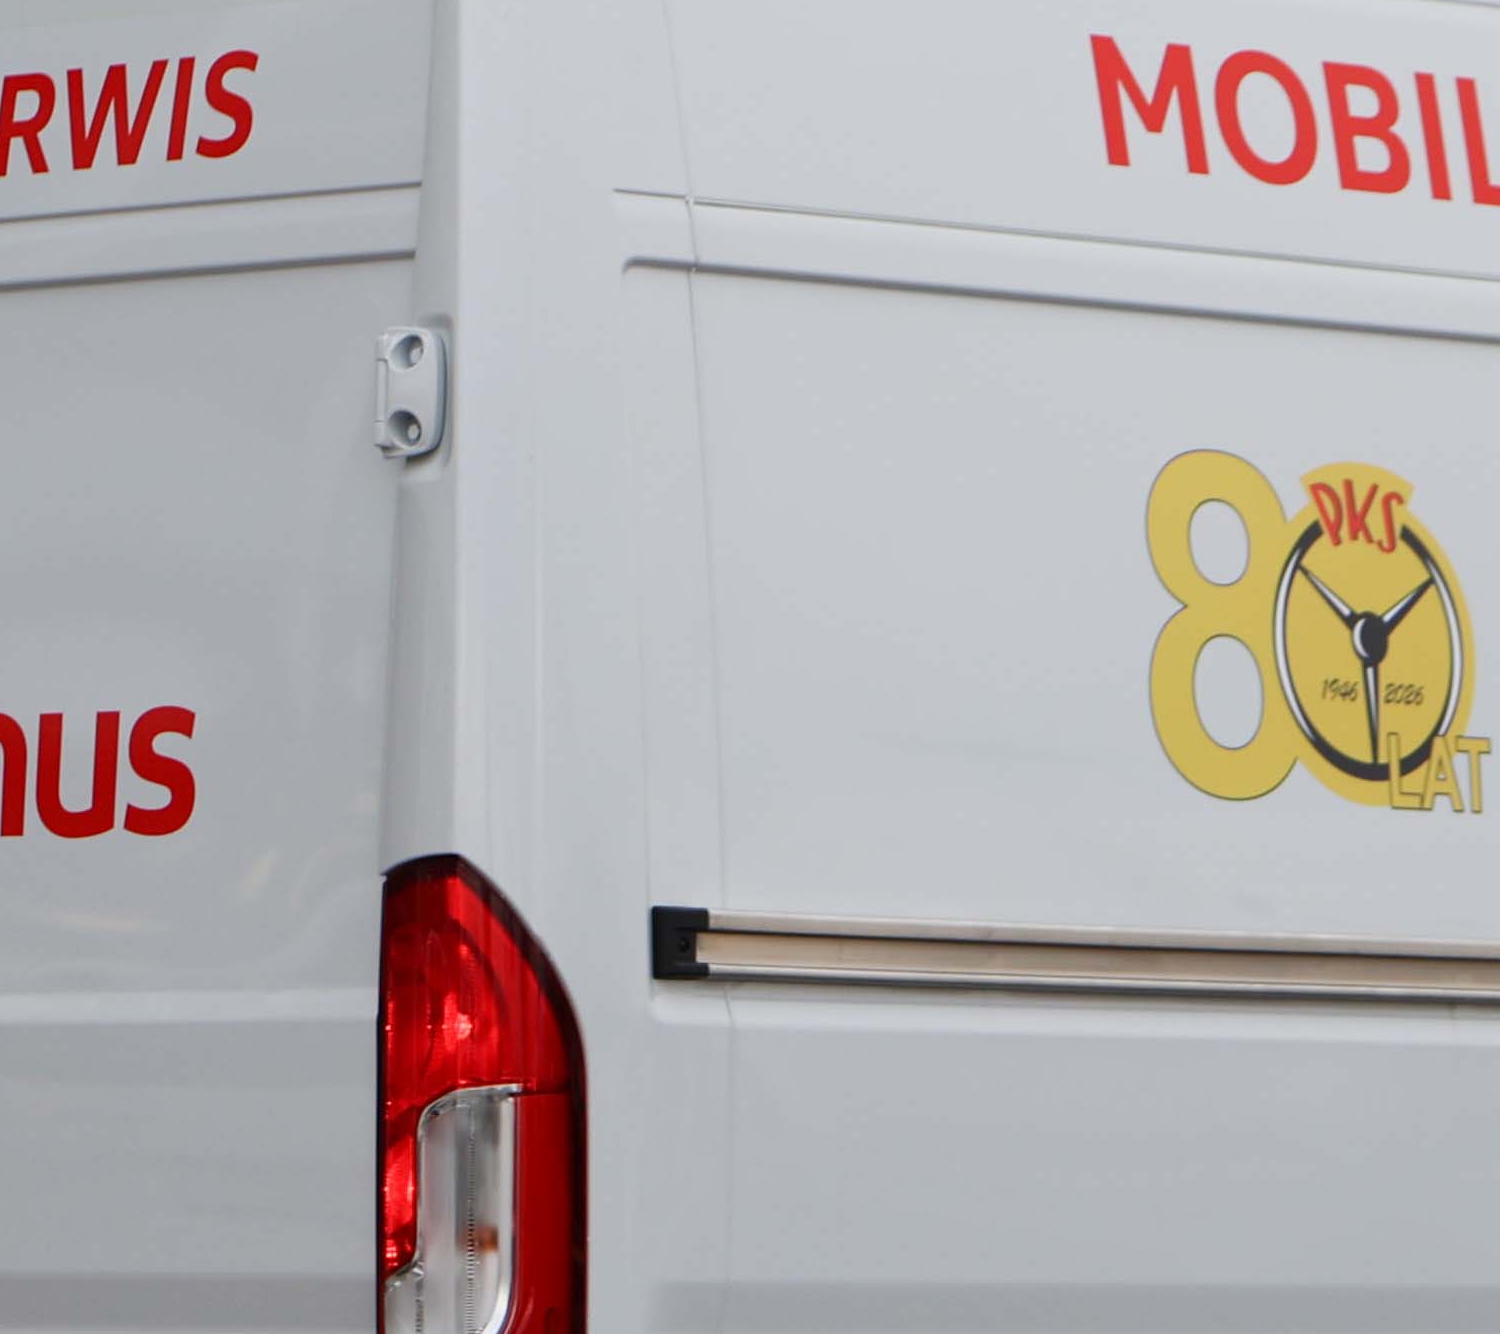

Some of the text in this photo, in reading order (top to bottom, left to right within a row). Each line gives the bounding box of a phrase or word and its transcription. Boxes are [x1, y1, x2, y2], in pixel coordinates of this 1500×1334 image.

[1310, 479, 1404, 553] PKS
[1383, 682, 1425, 706] 2026
[1386, 731, 1492, 814] LAT
